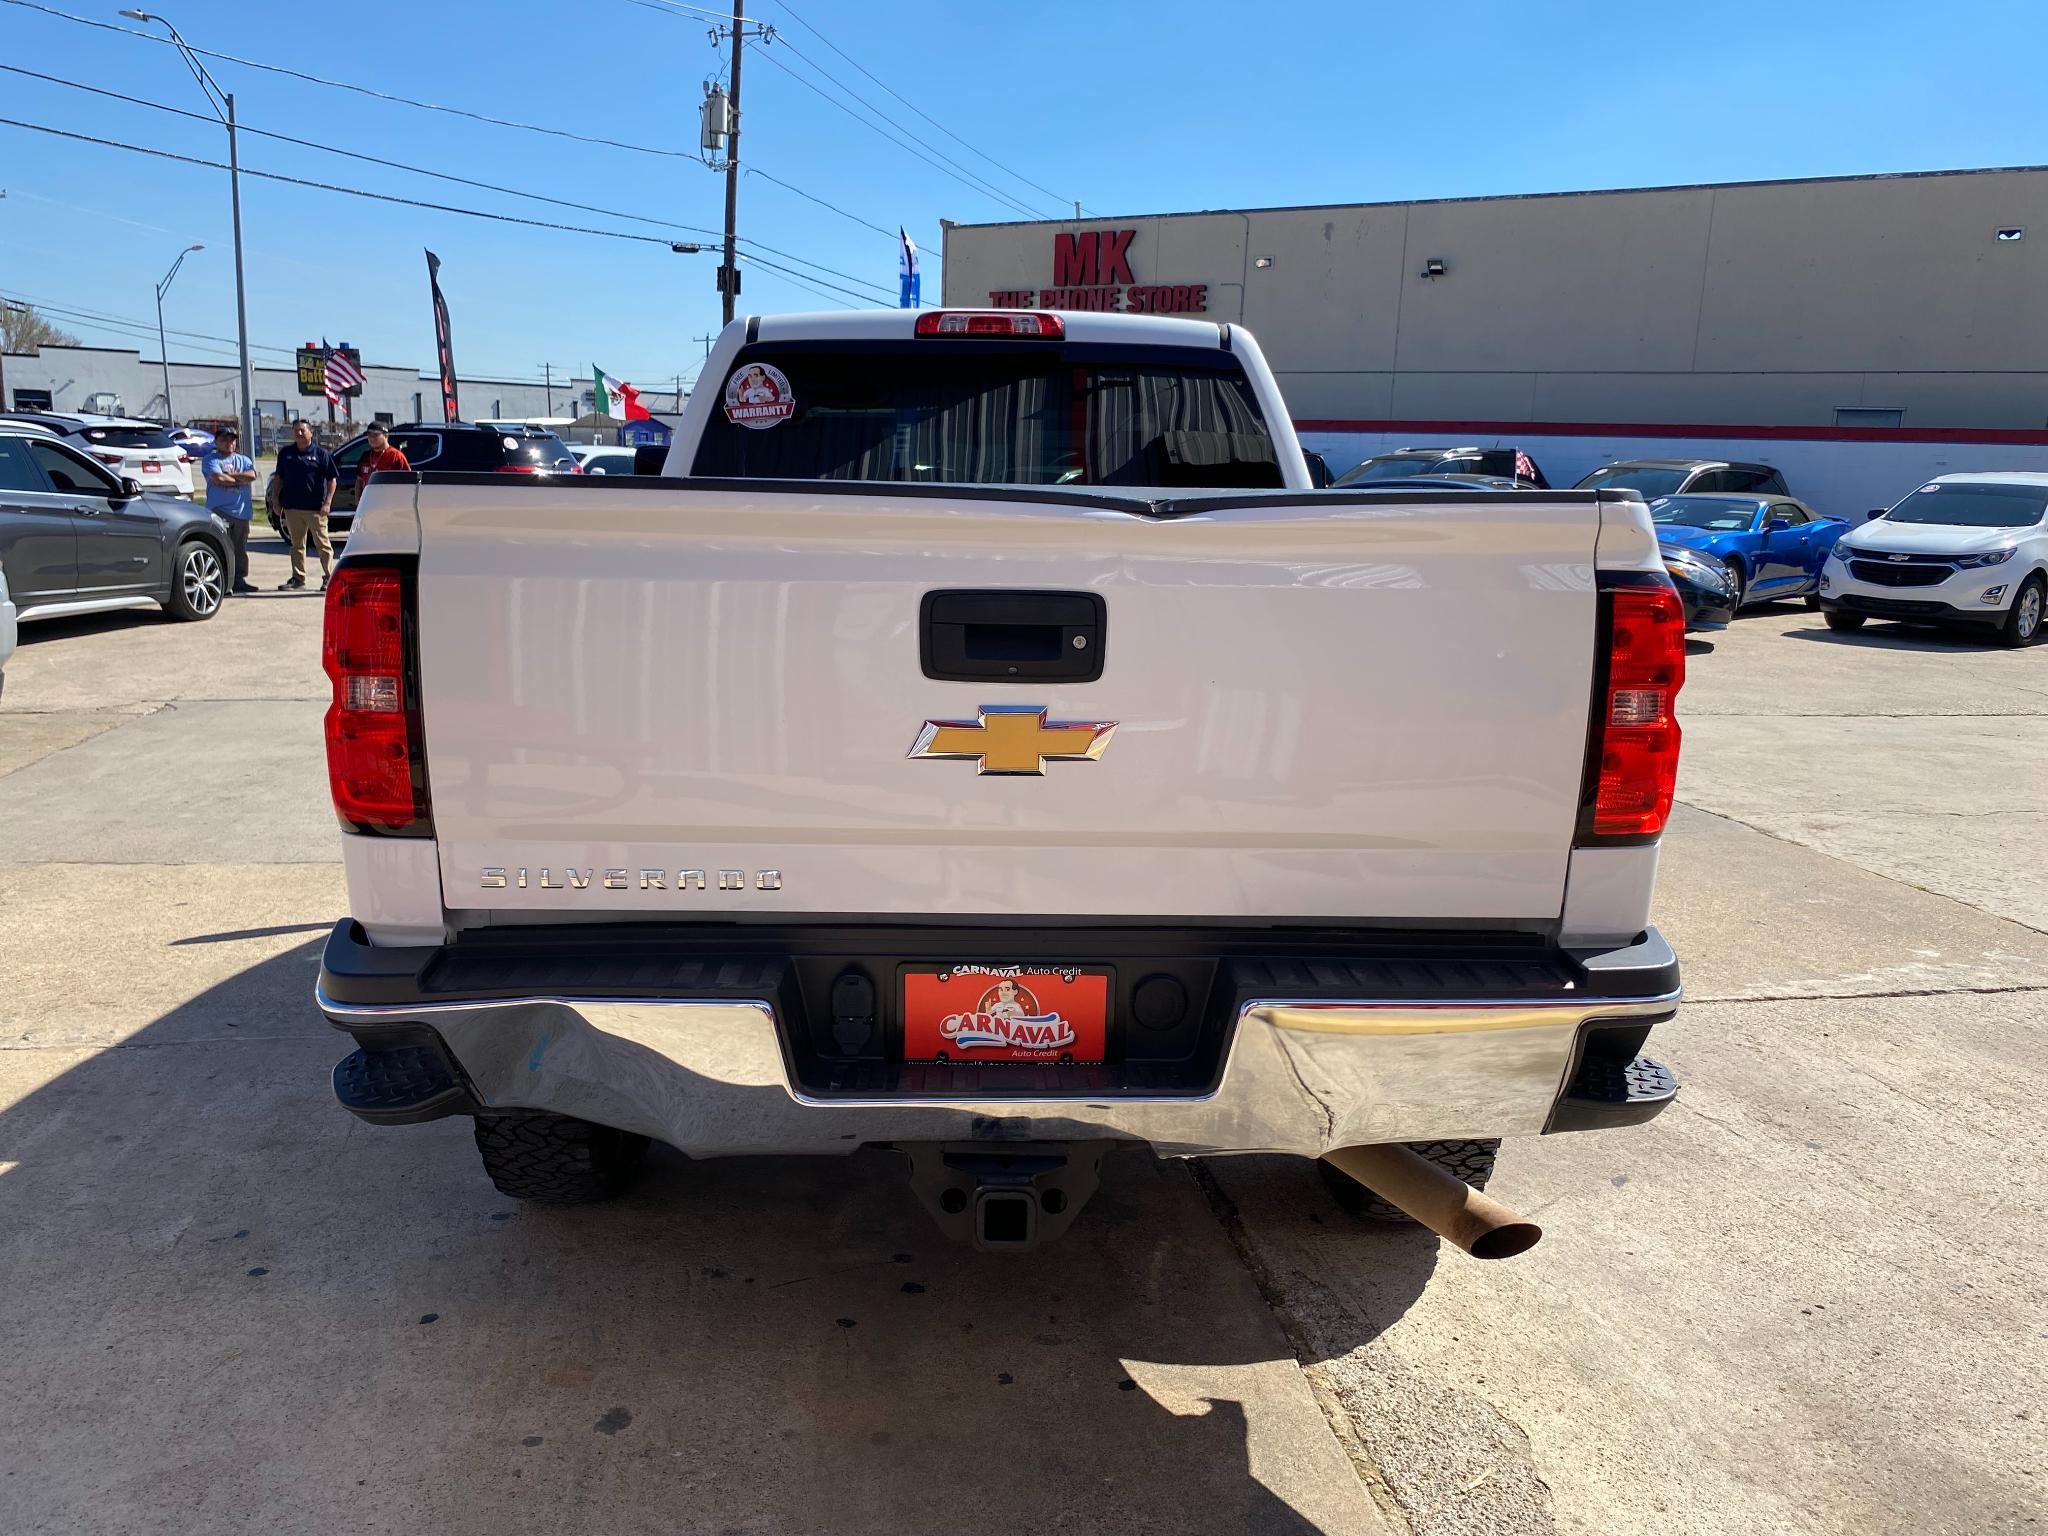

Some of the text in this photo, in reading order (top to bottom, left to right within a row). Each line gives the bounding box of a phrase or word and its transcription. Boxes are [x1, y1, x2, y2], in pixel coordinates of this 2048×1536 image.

[1054, 230, 1136, 286] MK
[989, 285, 1208, 313] THE PHONE STORE
[732, 405, 788, 419] WARRANTY
[480, 867, 783, 890] SILVERADO
[952, 965, 1082, 978] CARNAVAL Auto Credit
[940, 1012, 1075, 1048] CARNAVAL
